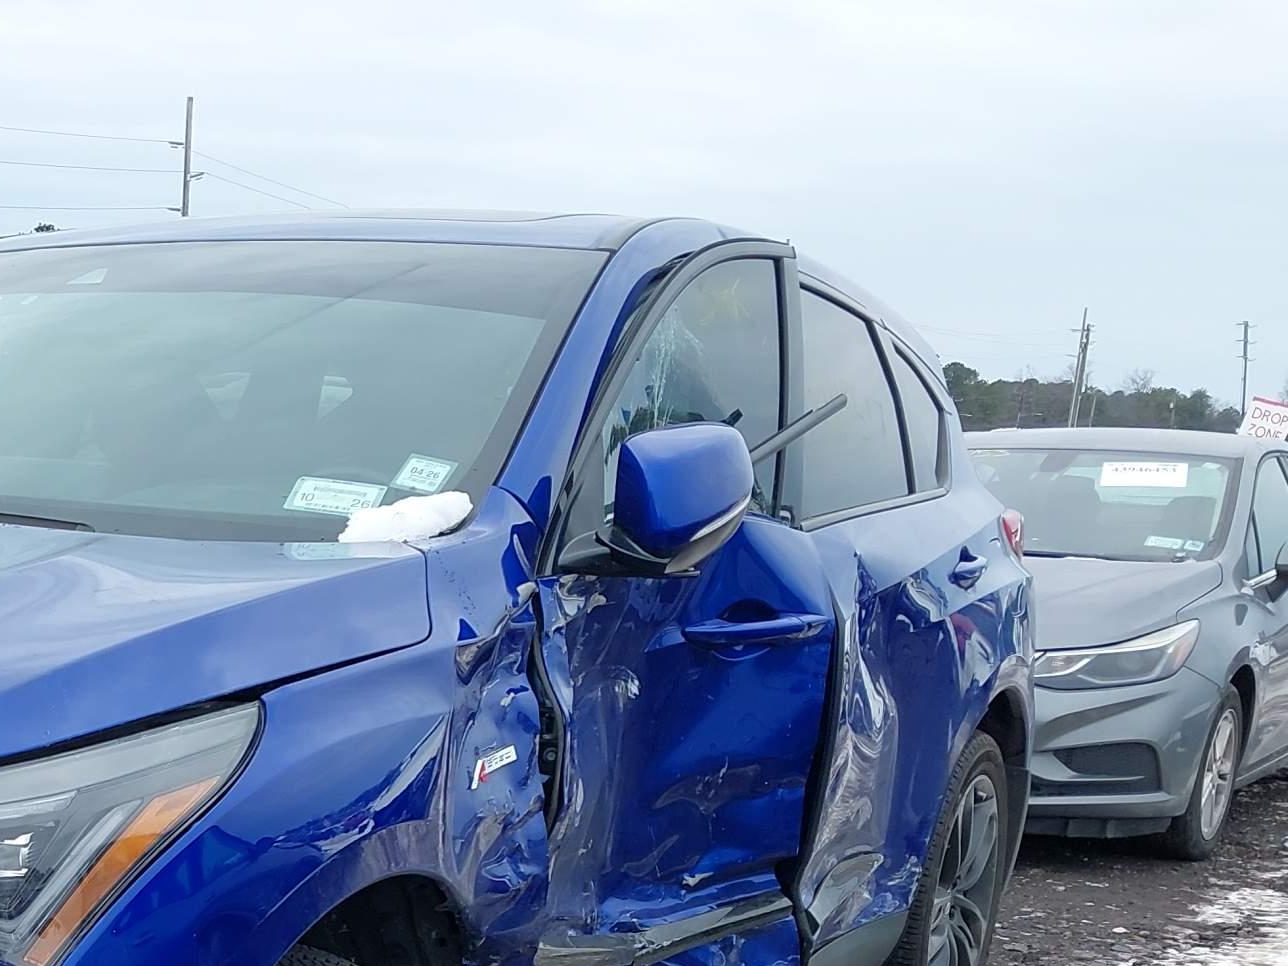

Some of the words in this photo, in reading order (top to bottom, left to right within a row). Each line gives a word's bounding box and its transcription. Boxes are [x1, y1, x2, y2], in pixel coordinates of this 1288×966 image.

[1251, 406, 1288, 426] DROP
[1247, 423, 1282, 439] ZONE
[299, 492, 315, 502] 10
[350, 498, 370, 508] 26
